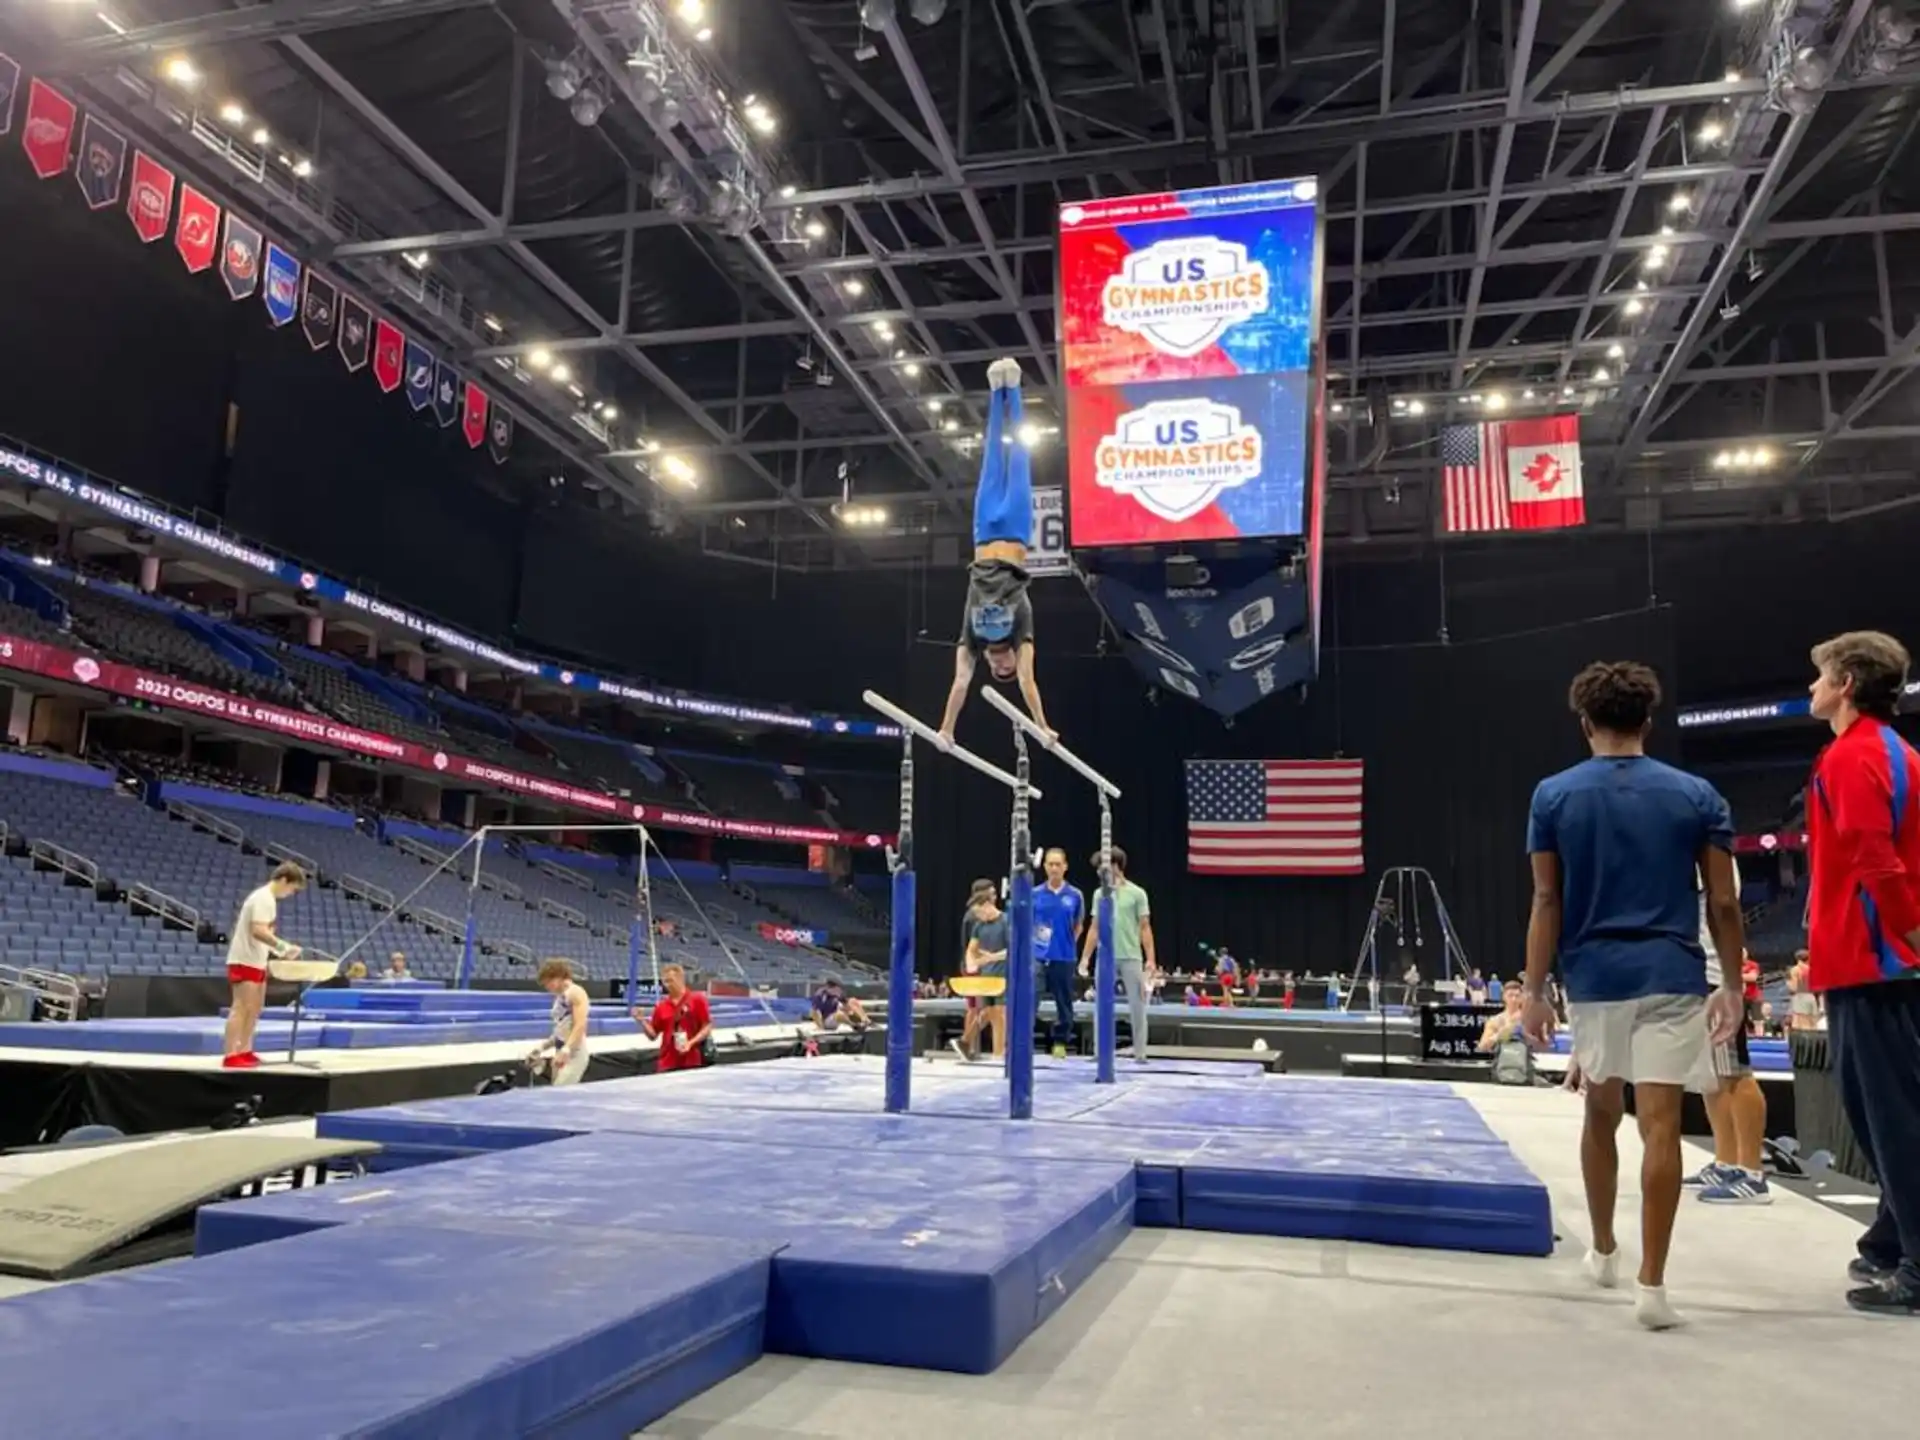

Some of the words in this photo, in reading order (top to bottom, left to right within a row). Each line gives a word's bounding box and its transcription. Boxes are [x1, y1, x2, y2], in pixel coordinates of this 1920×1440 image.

[1109, 273, 1262, 308] GYMNASTICS
[1120, 300, 1249, 320] CHAMPIONSHIPS
[1102, 437, 1256, 469] GYMNASTICS
[1114, 464, 1243, 481] CHAMPIONSHIPS
[79, 484, 171, 531] GYMNASTICS
[174, 523, 277, 573] CHAMPIONSHIPS
[135, 677, 171, 698] 2022
[172, 687, 225, 711] OOFOS
[254, 708, 325, 736] GYMNASTICS
[326, 727, 404, 757] CHAMPIONSHIPS
[1677, 704, 1779, 727] CHAMPIONSHIPS
[1429, 1039, 1452, 1056] Aug
